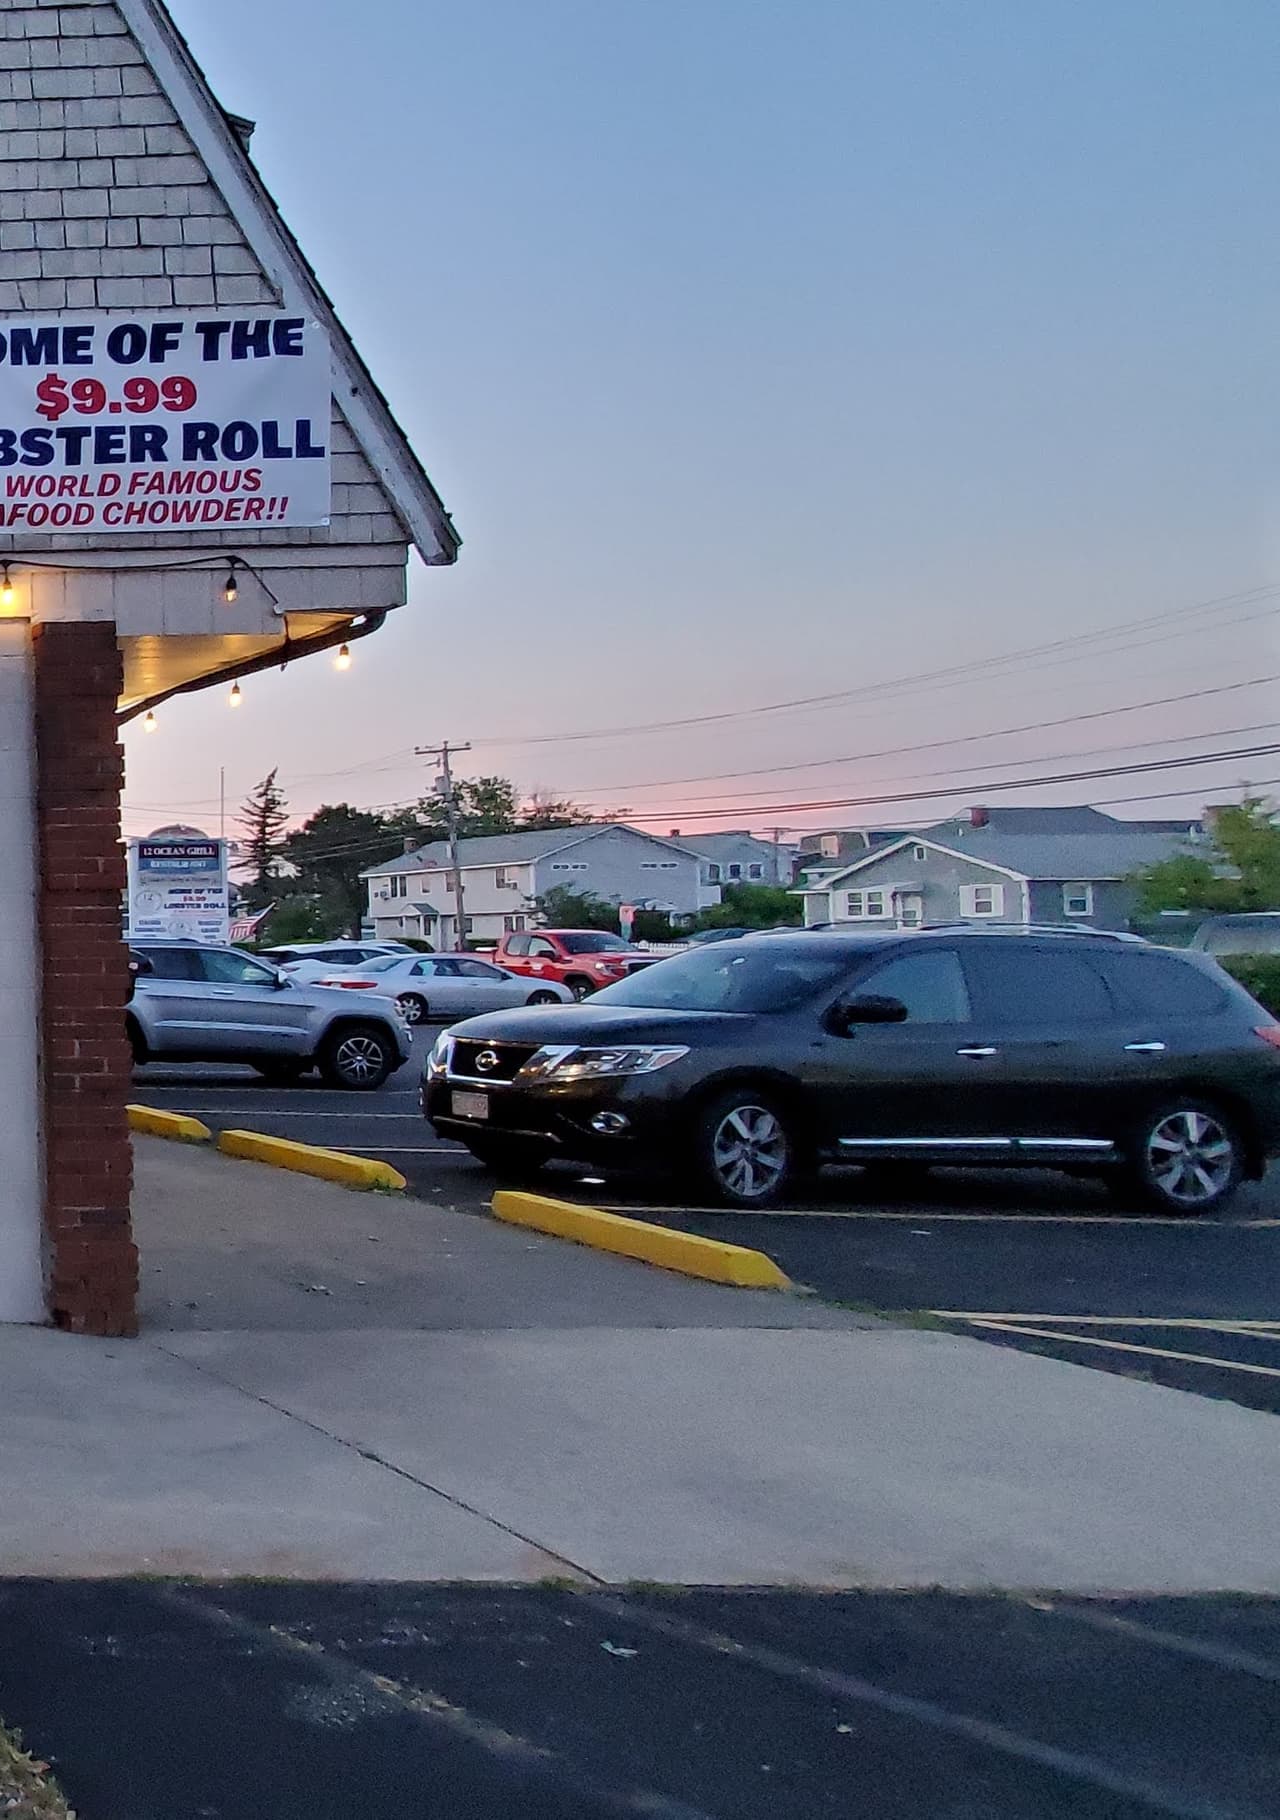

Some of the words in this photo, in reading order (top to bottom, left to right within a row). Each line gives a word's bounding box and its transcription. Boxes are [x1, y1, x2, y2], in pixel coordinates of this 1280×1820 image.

[107, 322, 184, 363] OF
[196, 318, 305, 361] THE
[36, 373, 197, 421] $9.99
[182, 420, 325, 462] ROLL
[5, 473, 121, 497] WORLD
[128, 468, 262, 495] FAMOUS
[103, 497, 289, 524] CHOWDER!!
[153, 847, 185, 856] OCEAN
[186, 847, 215, 856] GRILL
